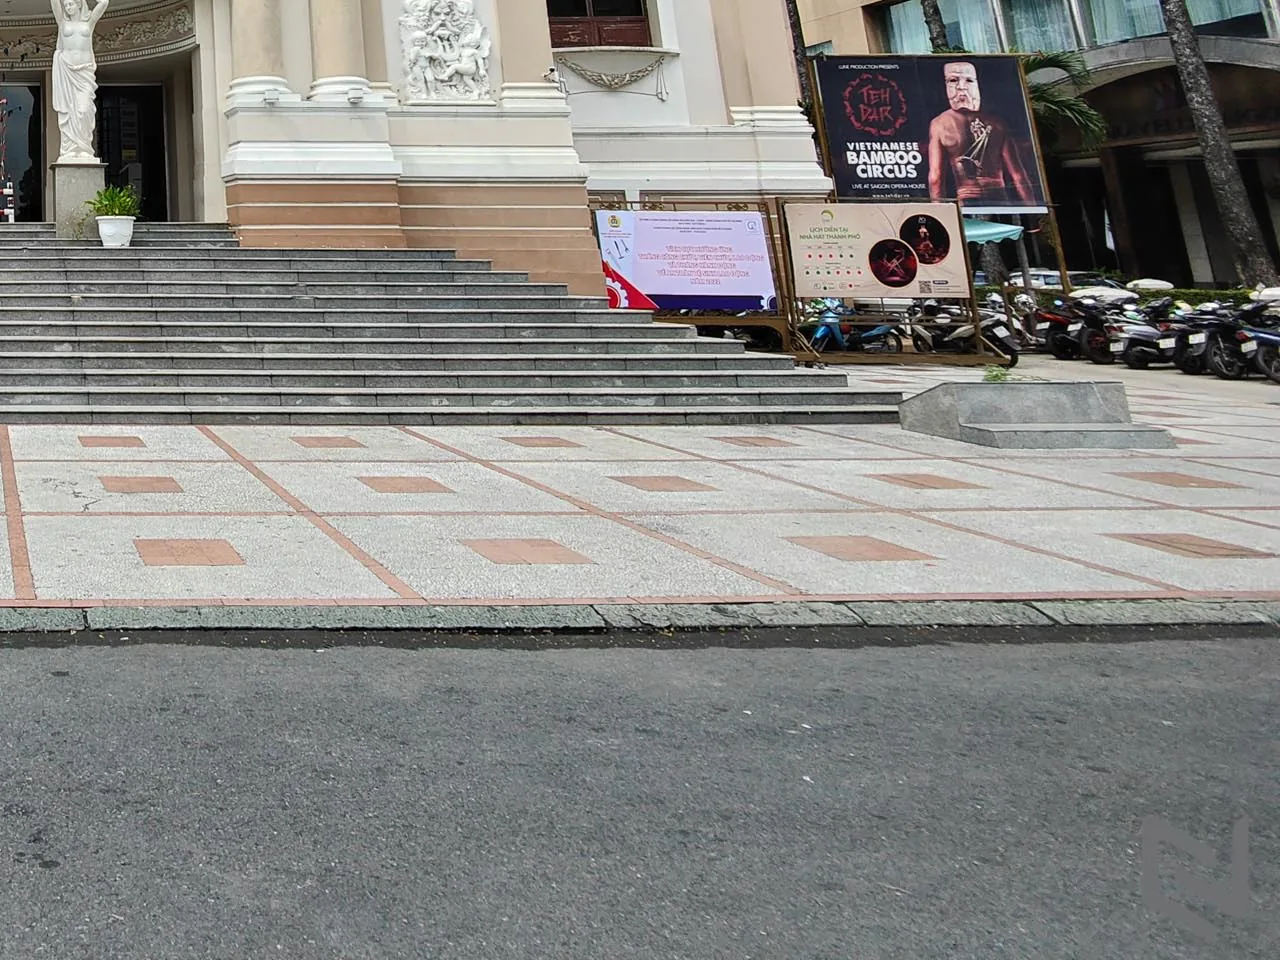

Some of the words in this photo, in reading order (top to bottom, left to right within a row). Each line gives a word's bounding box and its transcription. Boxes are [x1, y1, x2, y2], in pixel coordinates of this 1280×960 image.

[859, 85, 890, 104] TEH
[859, 104, 893, 121] DAR
[847, 142, 919, 151] VIETNAMESE
[846, 151, 922, 164] BAMBOO
[856, 164, 918, 179] CIRCUS
